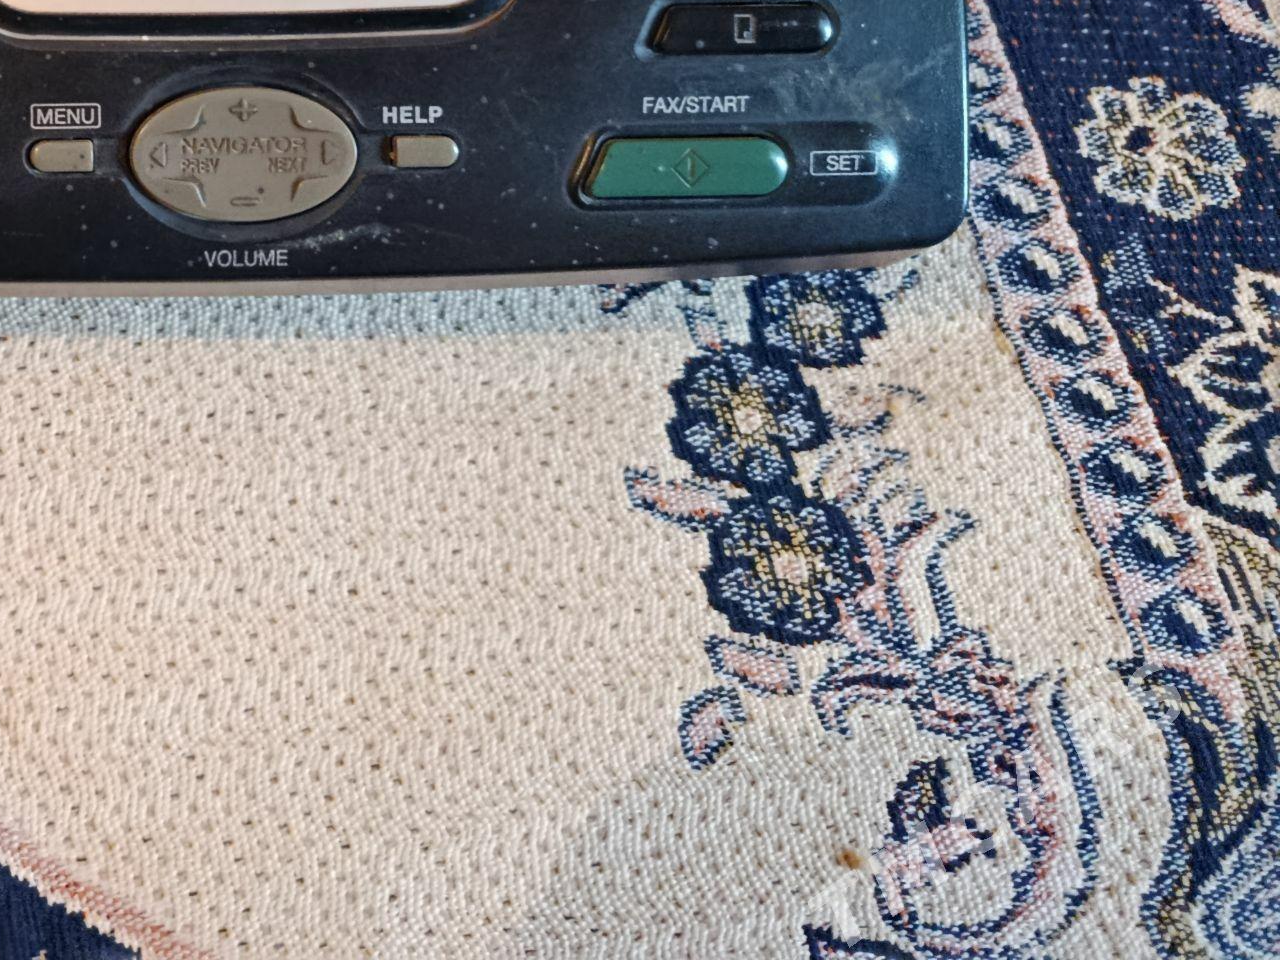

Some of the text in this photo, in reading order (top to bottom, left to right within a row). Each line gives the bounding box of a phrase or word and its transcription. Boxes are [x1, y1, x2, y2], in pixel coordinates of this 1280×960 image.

[642, 95, 751, 114] FAX/START
[35, 107, 97, 127] MENU
[381, 105, 444, 125] HELP
[181, 136, 308, 155] NAVIGATOR
[181, 157, 221, 174] PREV
[268, 157, 308, 173] NEXT
[826, 154, 862, 171] SET
[204, 250, 289, 267] VOLUME
